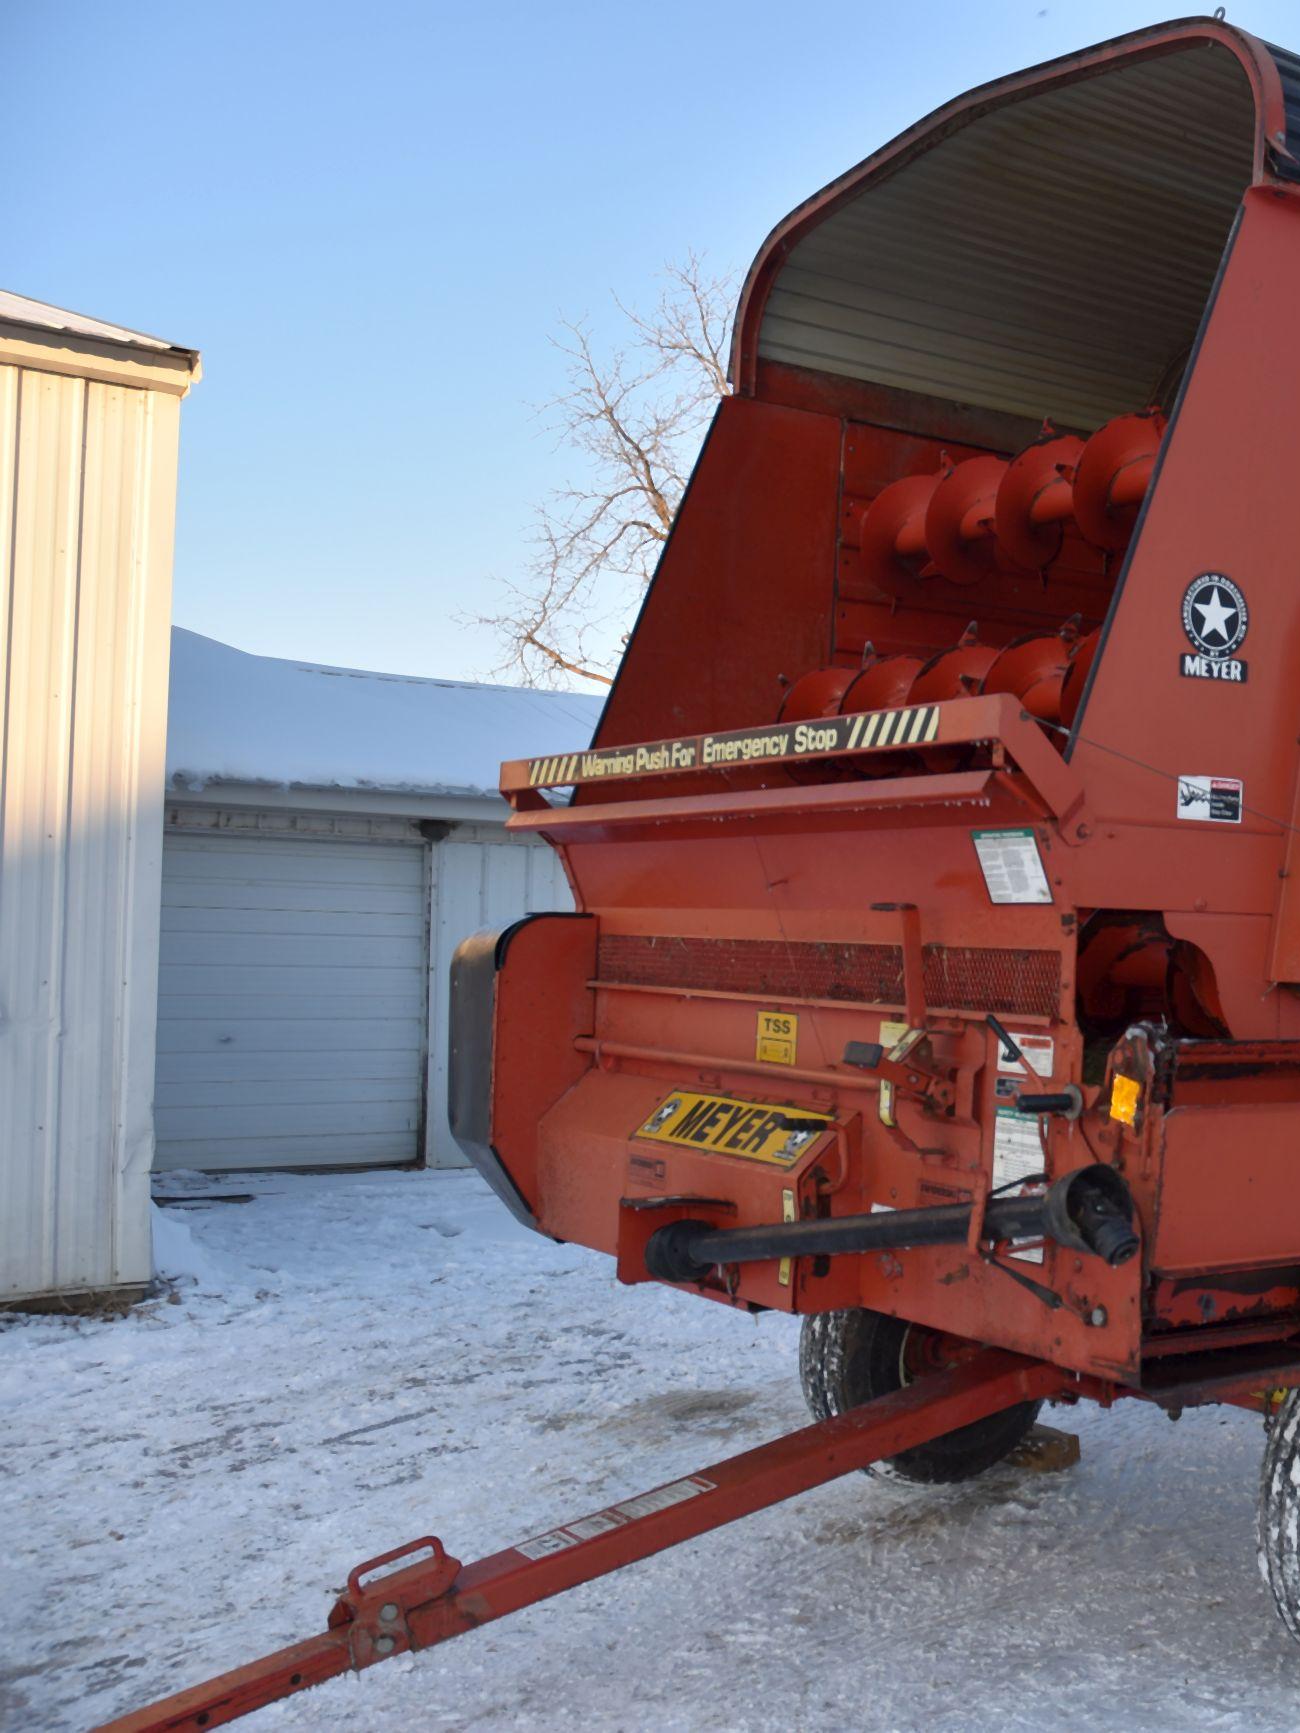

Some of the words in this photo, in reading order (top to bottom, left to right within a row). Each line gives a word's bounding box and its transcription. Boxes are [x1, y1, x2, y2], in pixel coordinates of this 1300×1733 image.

[1184, 655, 1242, 681] MEYER
[581, 751, 634, 777] Warning
[635, 745, 670, 771] Push
[671, 742, 696, 767] For
[702, 734, 789, 763] Emergency
[794, 725, 838, 753] Stop
[764, 1017, 791, 1035] TSS
[669, 1100, 786, 1153] MEYER
